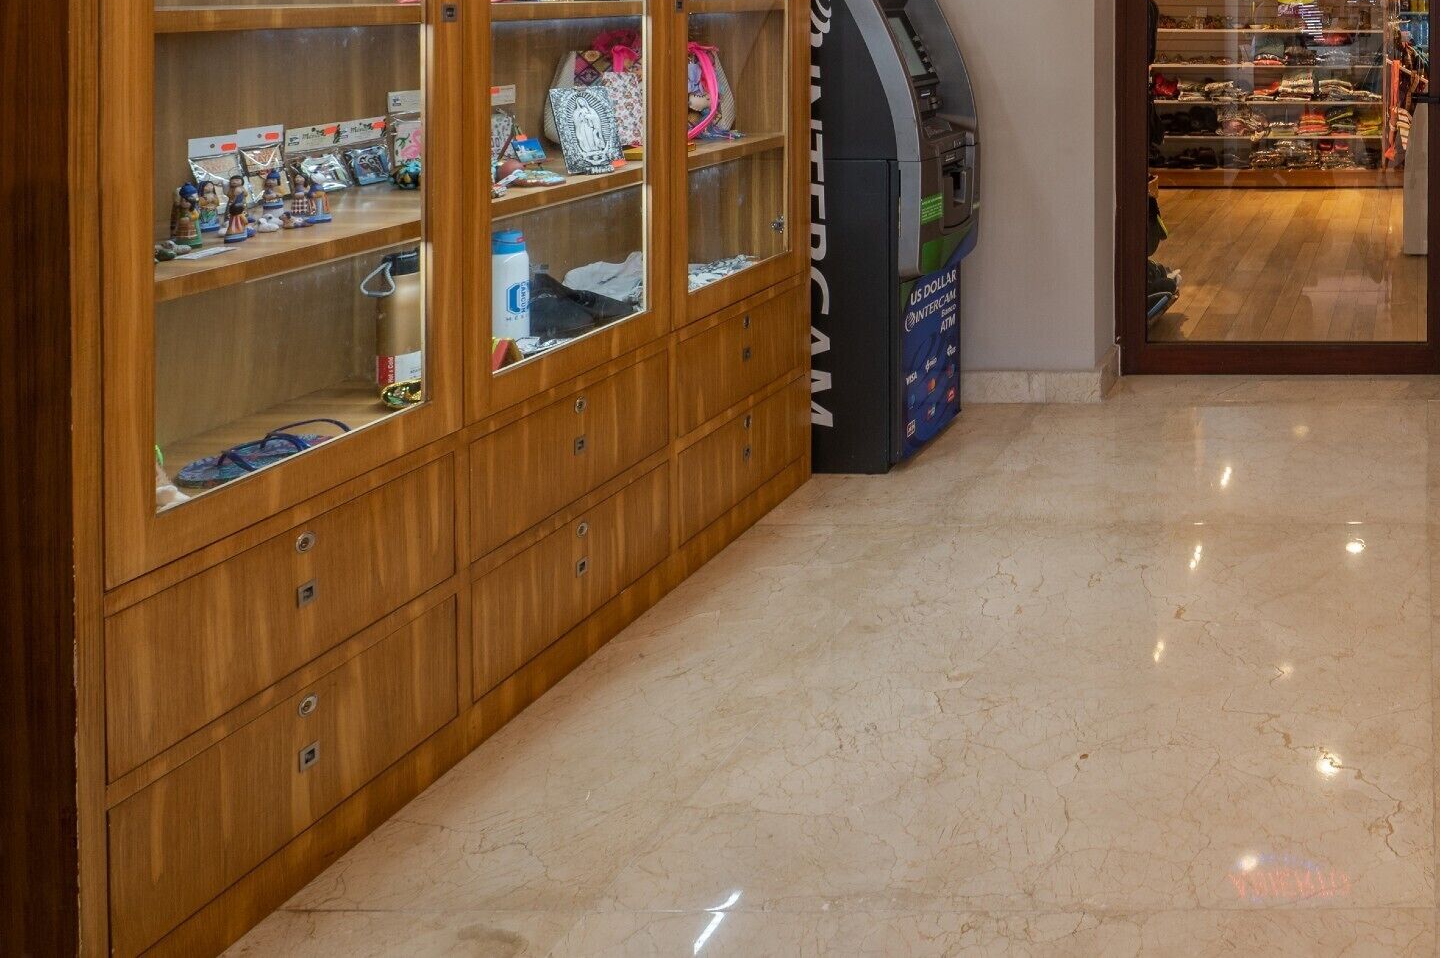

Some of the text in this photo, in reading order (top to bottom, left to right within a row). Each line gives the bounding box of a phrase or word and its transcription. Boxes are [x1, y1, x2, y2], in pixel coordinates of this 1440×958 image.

[910, 269, 957, 306] US DOLLAR
[915, 288, 956, 324] INTERCAM
[940, 313, 956, 334] ATM
